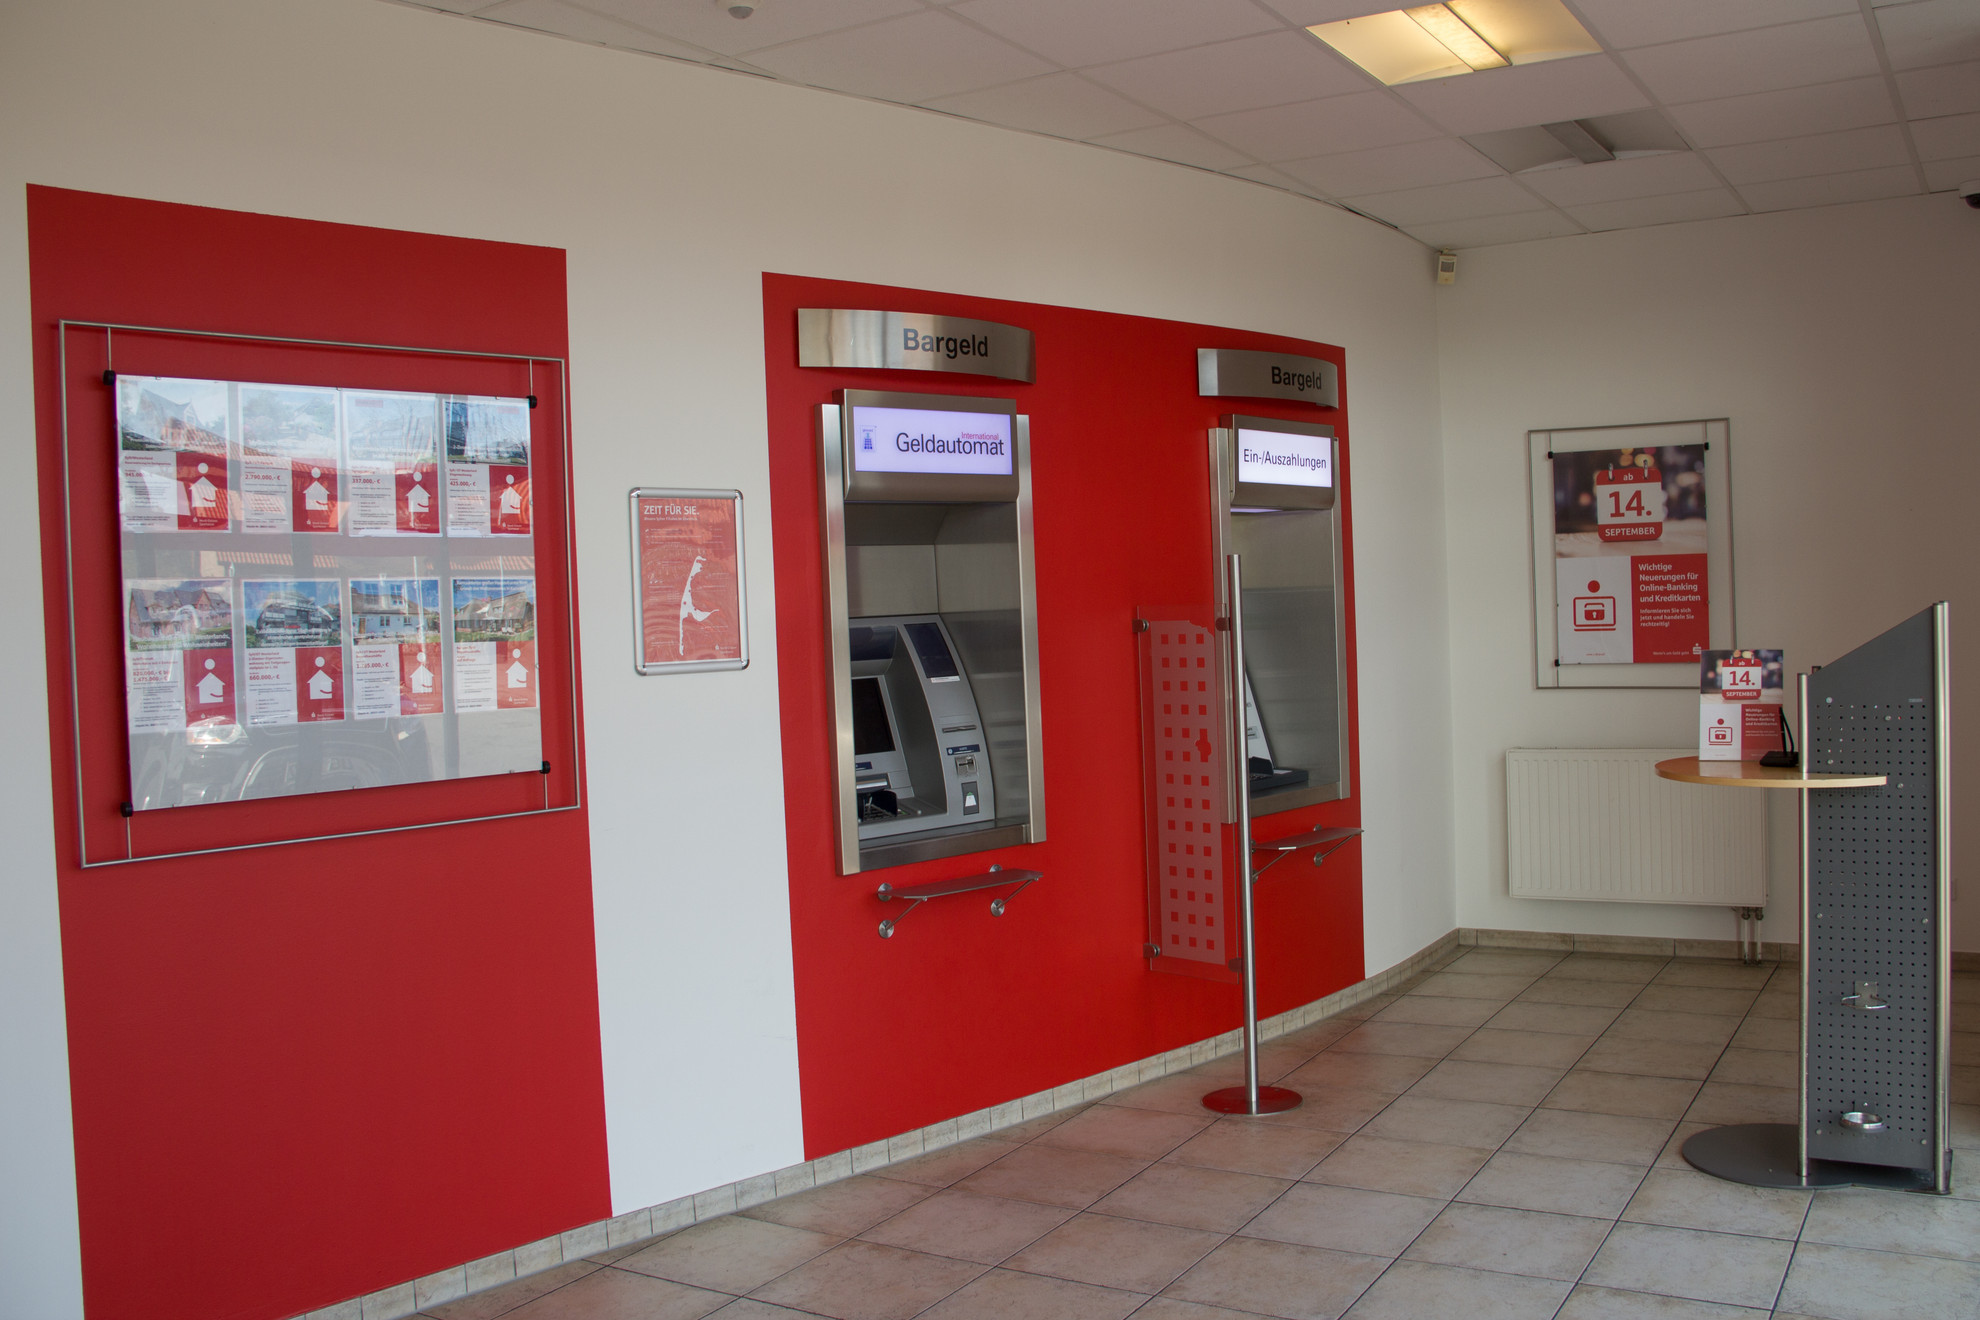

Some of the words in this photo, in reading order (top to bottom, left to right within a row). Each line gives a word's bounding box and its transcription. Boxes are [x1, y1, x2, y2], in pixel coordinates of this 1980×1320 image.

[903, 328, 988, 359] Bargeld
[1271, 366, 1322, 391] Bargeld
[962, 432, 999, 440] International
[896, 432, 1004, 456] Geldautomat
[1243, 448, 1327, 471] Ein-/Auszahlungen
[644, 506, 662, 515] ZEIT
[665, 504, 681, 515] FÜR
[684, 506, 700, 515] SIE.
[1608, 490, 1652, 518] 14.
[1605, 526, 1656, 537] SEPTEMBER
[1638, 562, 1672, 571] Wichtige
[1639, 573, 1686, 582] Neuerungen
[1687, 572, 1699, 581] für
[1640, 583, 1698, 592] Online-Banking
[1655, 594, 1701, 602] Kreditkarten
[1729, 671, 1755, 686] 14.
